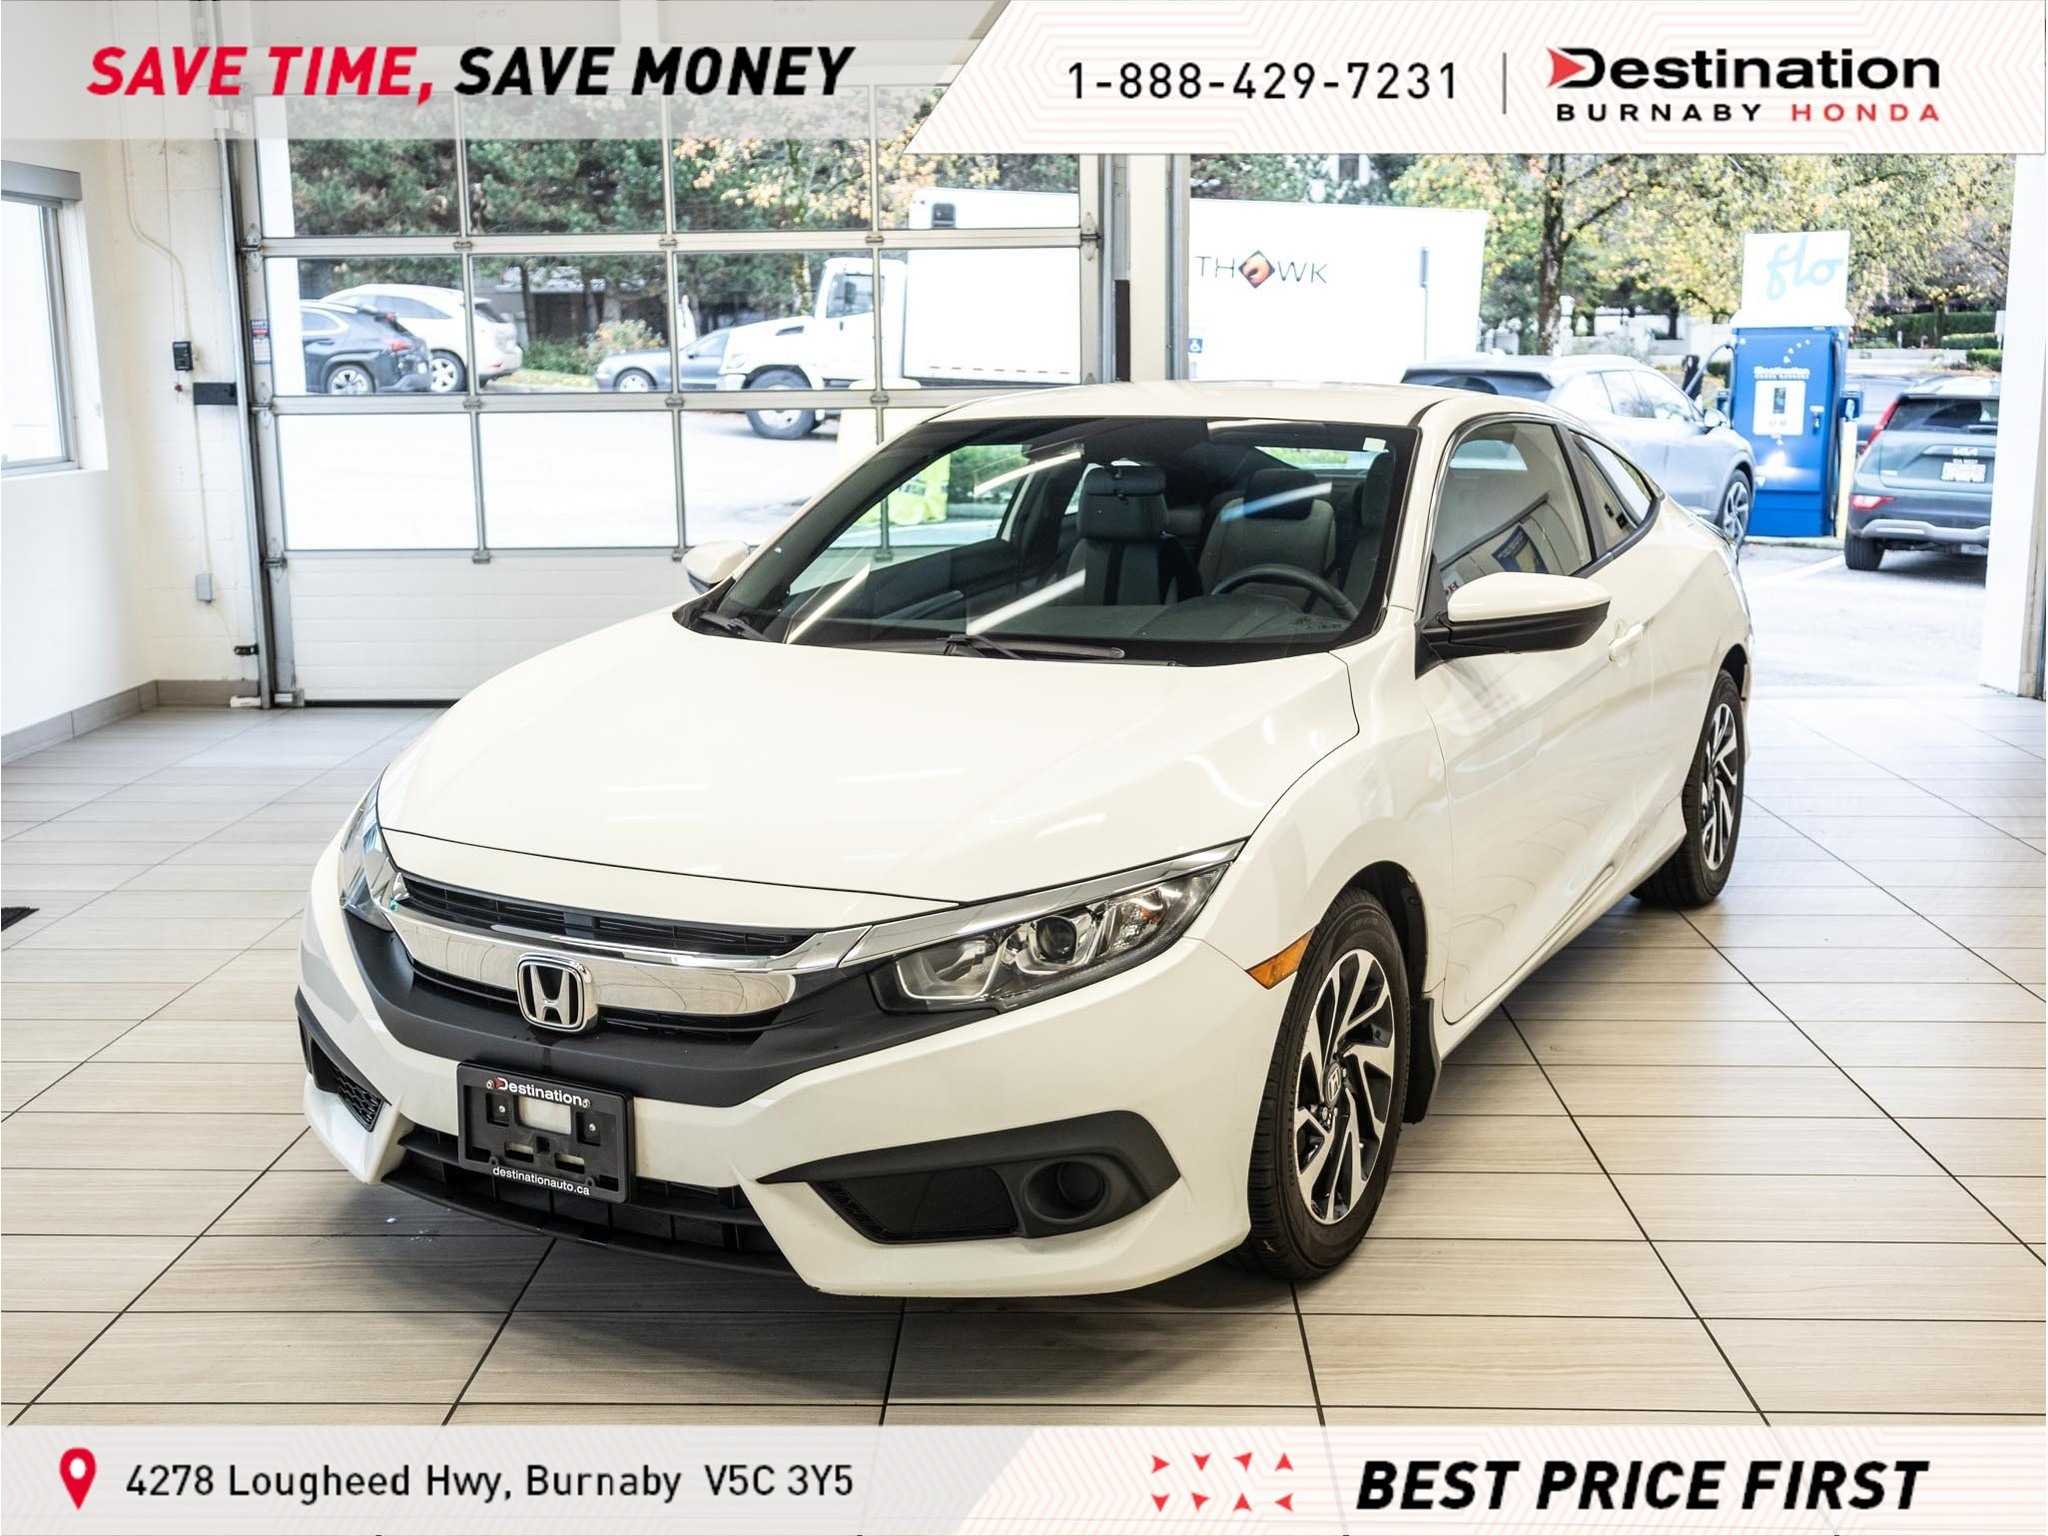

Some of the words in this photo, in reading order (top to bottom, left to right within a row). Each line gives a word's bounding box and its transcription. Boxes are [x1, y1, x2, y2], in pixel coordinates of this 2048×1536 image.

[1766, 235, 1844, 300] flo
[495, 1077, 583, 1107] Destination
[492, 1166, 590, 1196] destinationauto.ca
